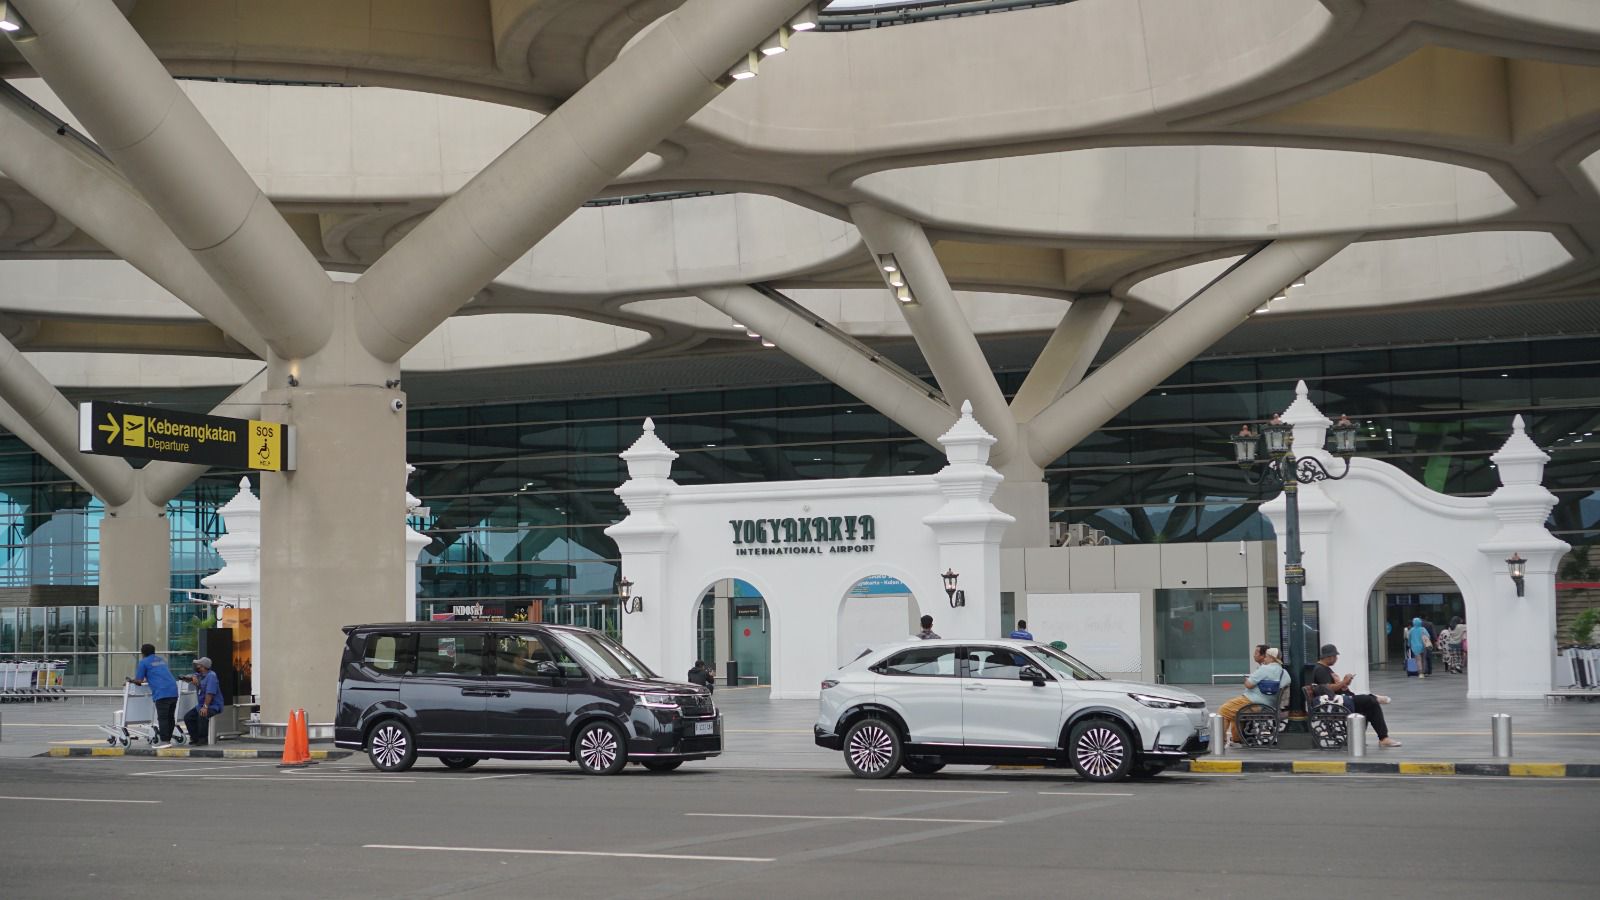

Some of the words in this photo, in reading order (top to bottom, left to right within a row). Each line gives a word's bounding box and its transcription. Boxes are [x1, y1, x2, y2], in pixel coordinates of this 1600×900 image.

[147, 417, 236, 443] Keberangkatan
[256, 426, 273, 438] SOS
[147, 437, 190, 452] Departure
[729, 514, 876, 544] YOGYAKARTA
[736, 546, 823, 556] INTERNATIONAL
[830, 545, 875, 553] AIRPORT
